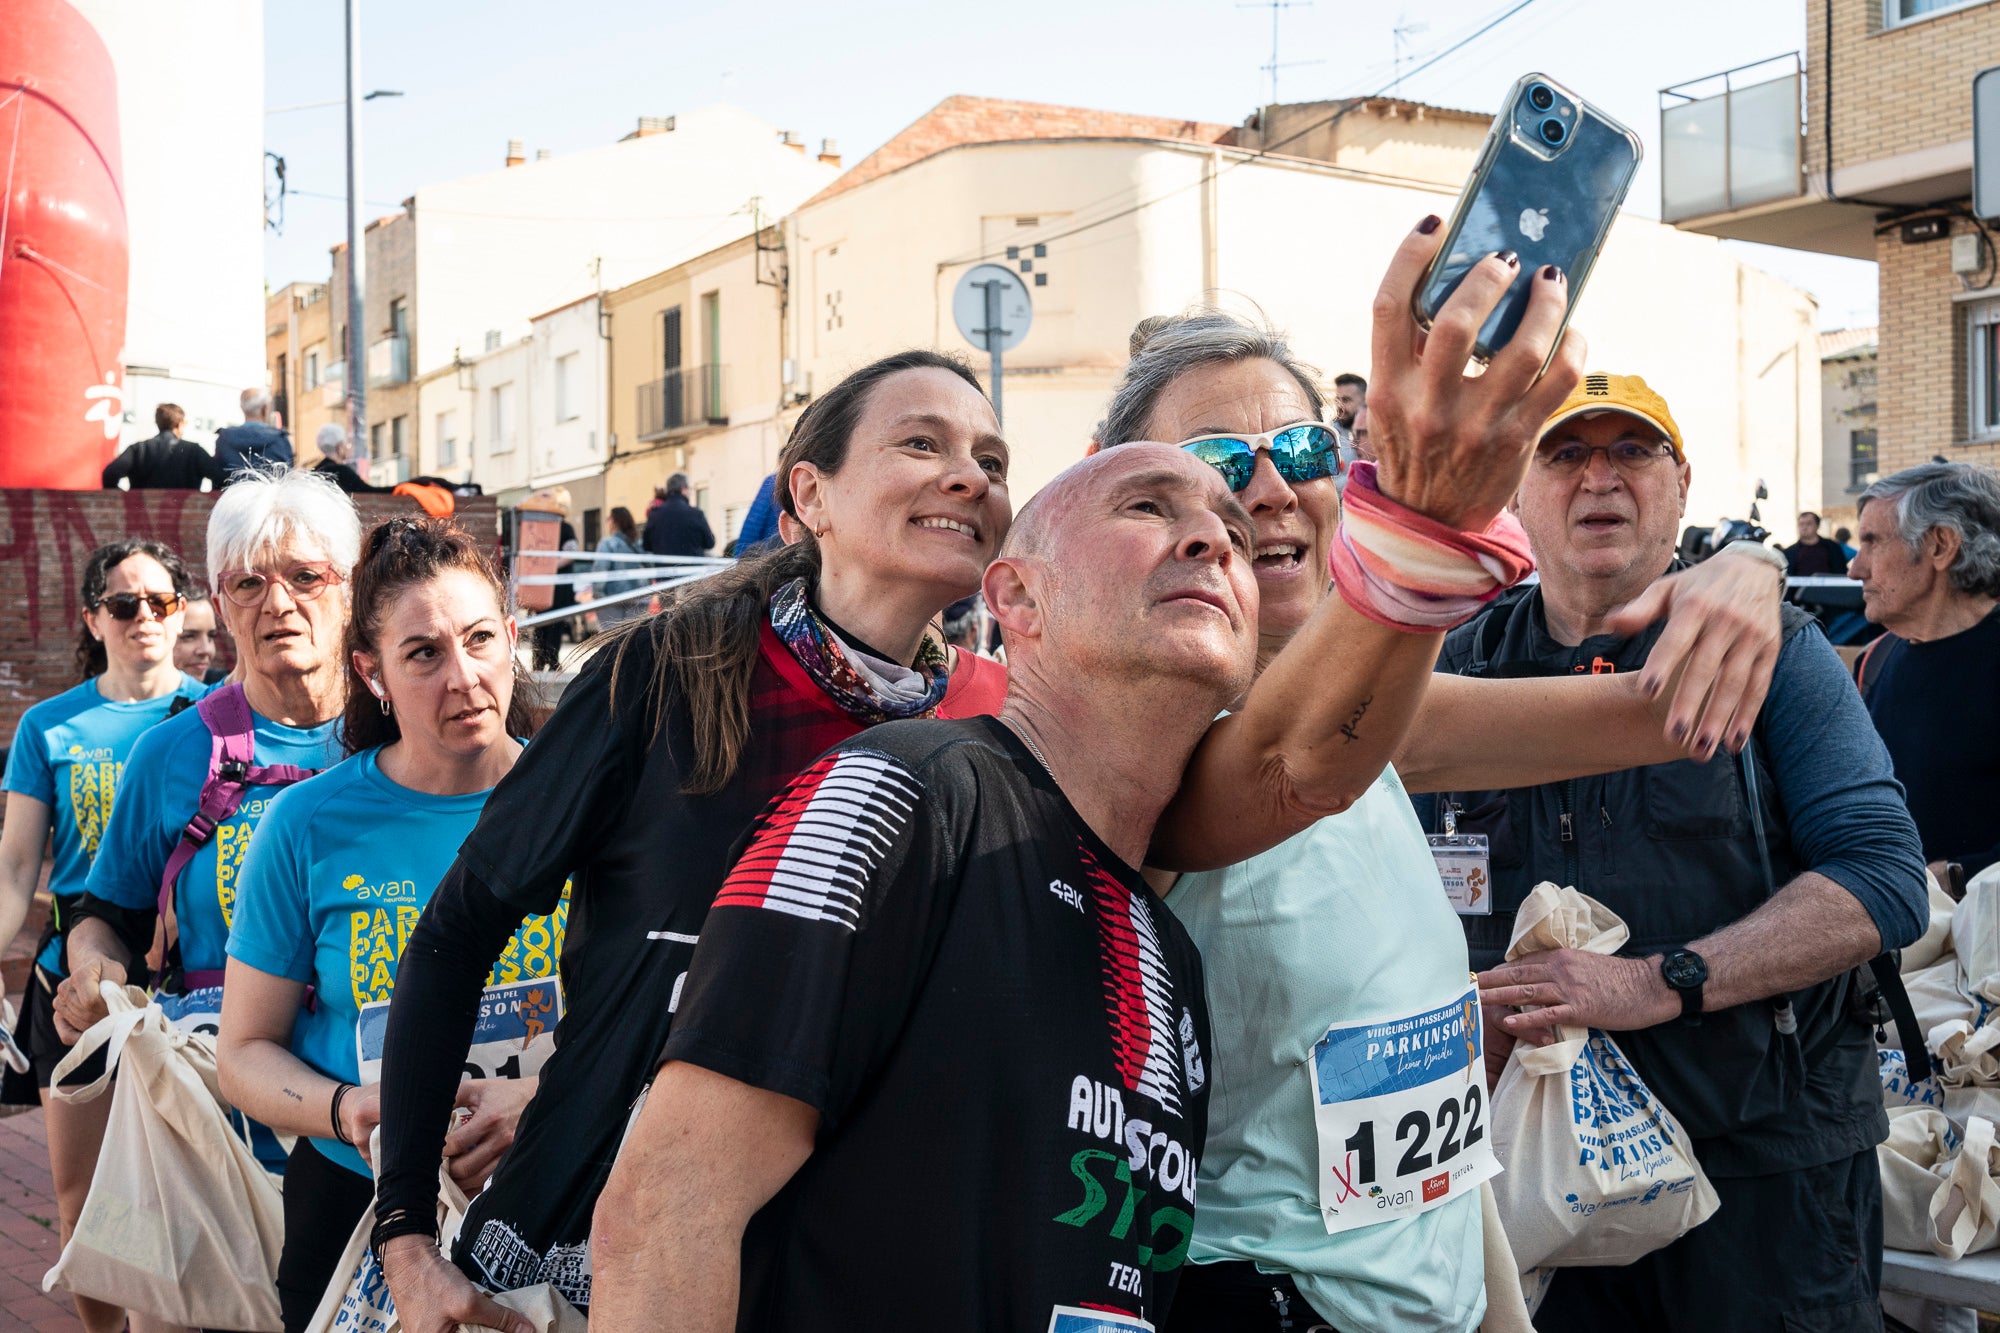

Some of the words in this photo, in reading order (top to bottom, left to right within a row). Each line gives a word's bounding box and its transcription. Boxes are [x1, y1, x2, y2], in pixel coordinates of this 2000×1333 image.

[357, 880, 416, 899] avan
[503, 990, 518, 1000] PEL
[1419, 1008, 1456, 1027] PASSEJADA
[1366, 1016, 1465, 1061] PARKINSON
[1345, 1084, 1483, 1184] 1222
[1377, 1189, 1414, 1209] avan
